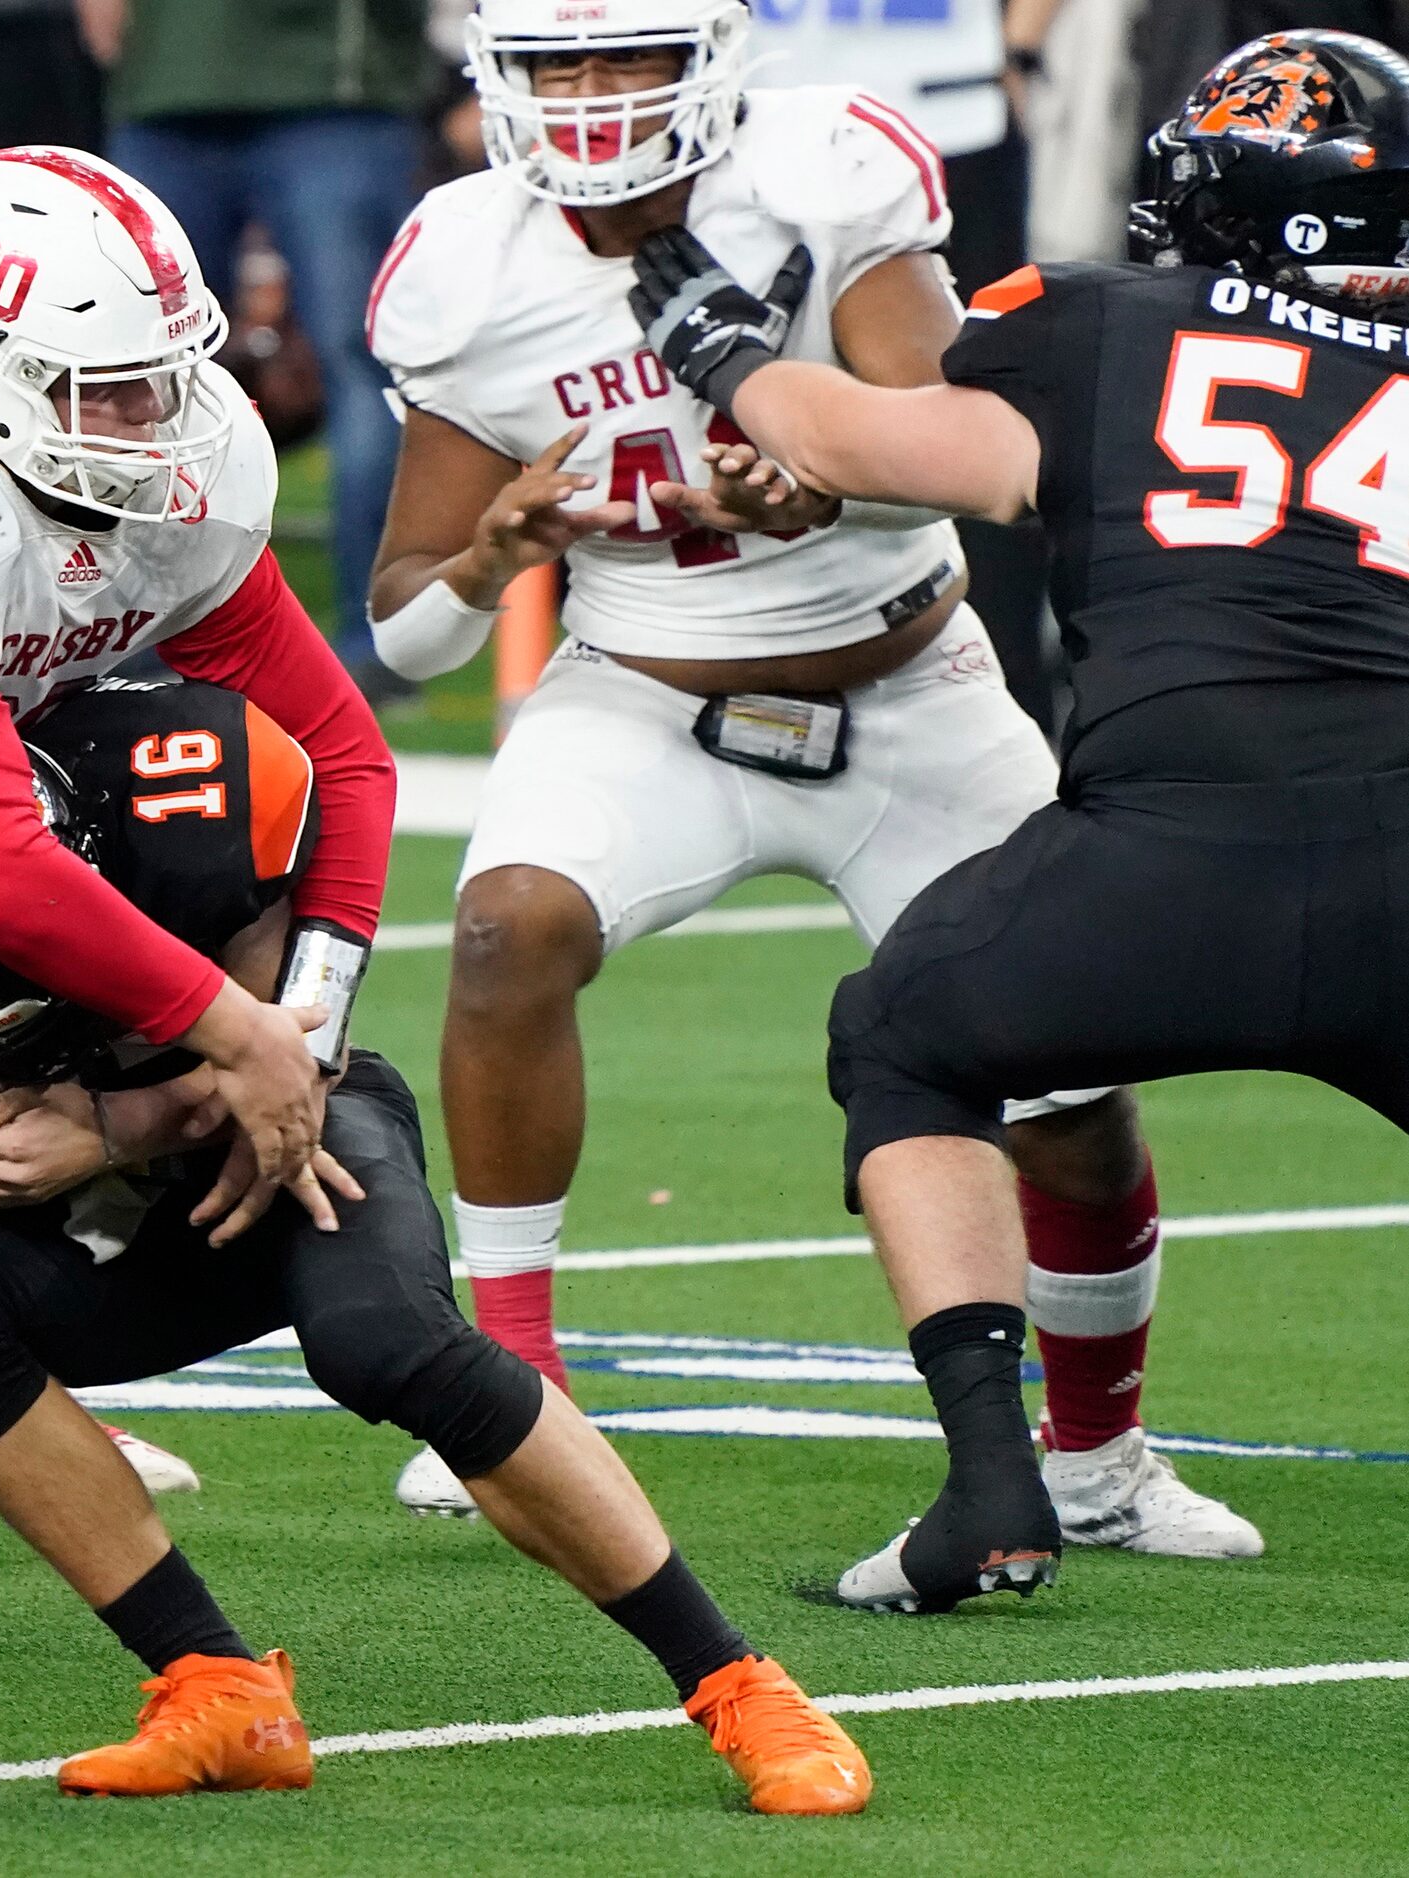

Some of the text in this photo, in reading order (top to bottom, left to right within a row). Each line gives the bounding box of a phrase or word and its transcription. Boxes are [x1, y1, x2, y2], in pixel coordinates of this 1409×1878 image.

[1295, 220, 1319, 249] T
[167, 309, 202, 340] EAT-TNT
[1210, 277, 1409, 355] O'KEEF
[552, 348, 670, 420] CRO
[1143, 329, 1409, 581] 54
[57, 568, 102, 584] adidas
[131, 729, 227, 824] 16
